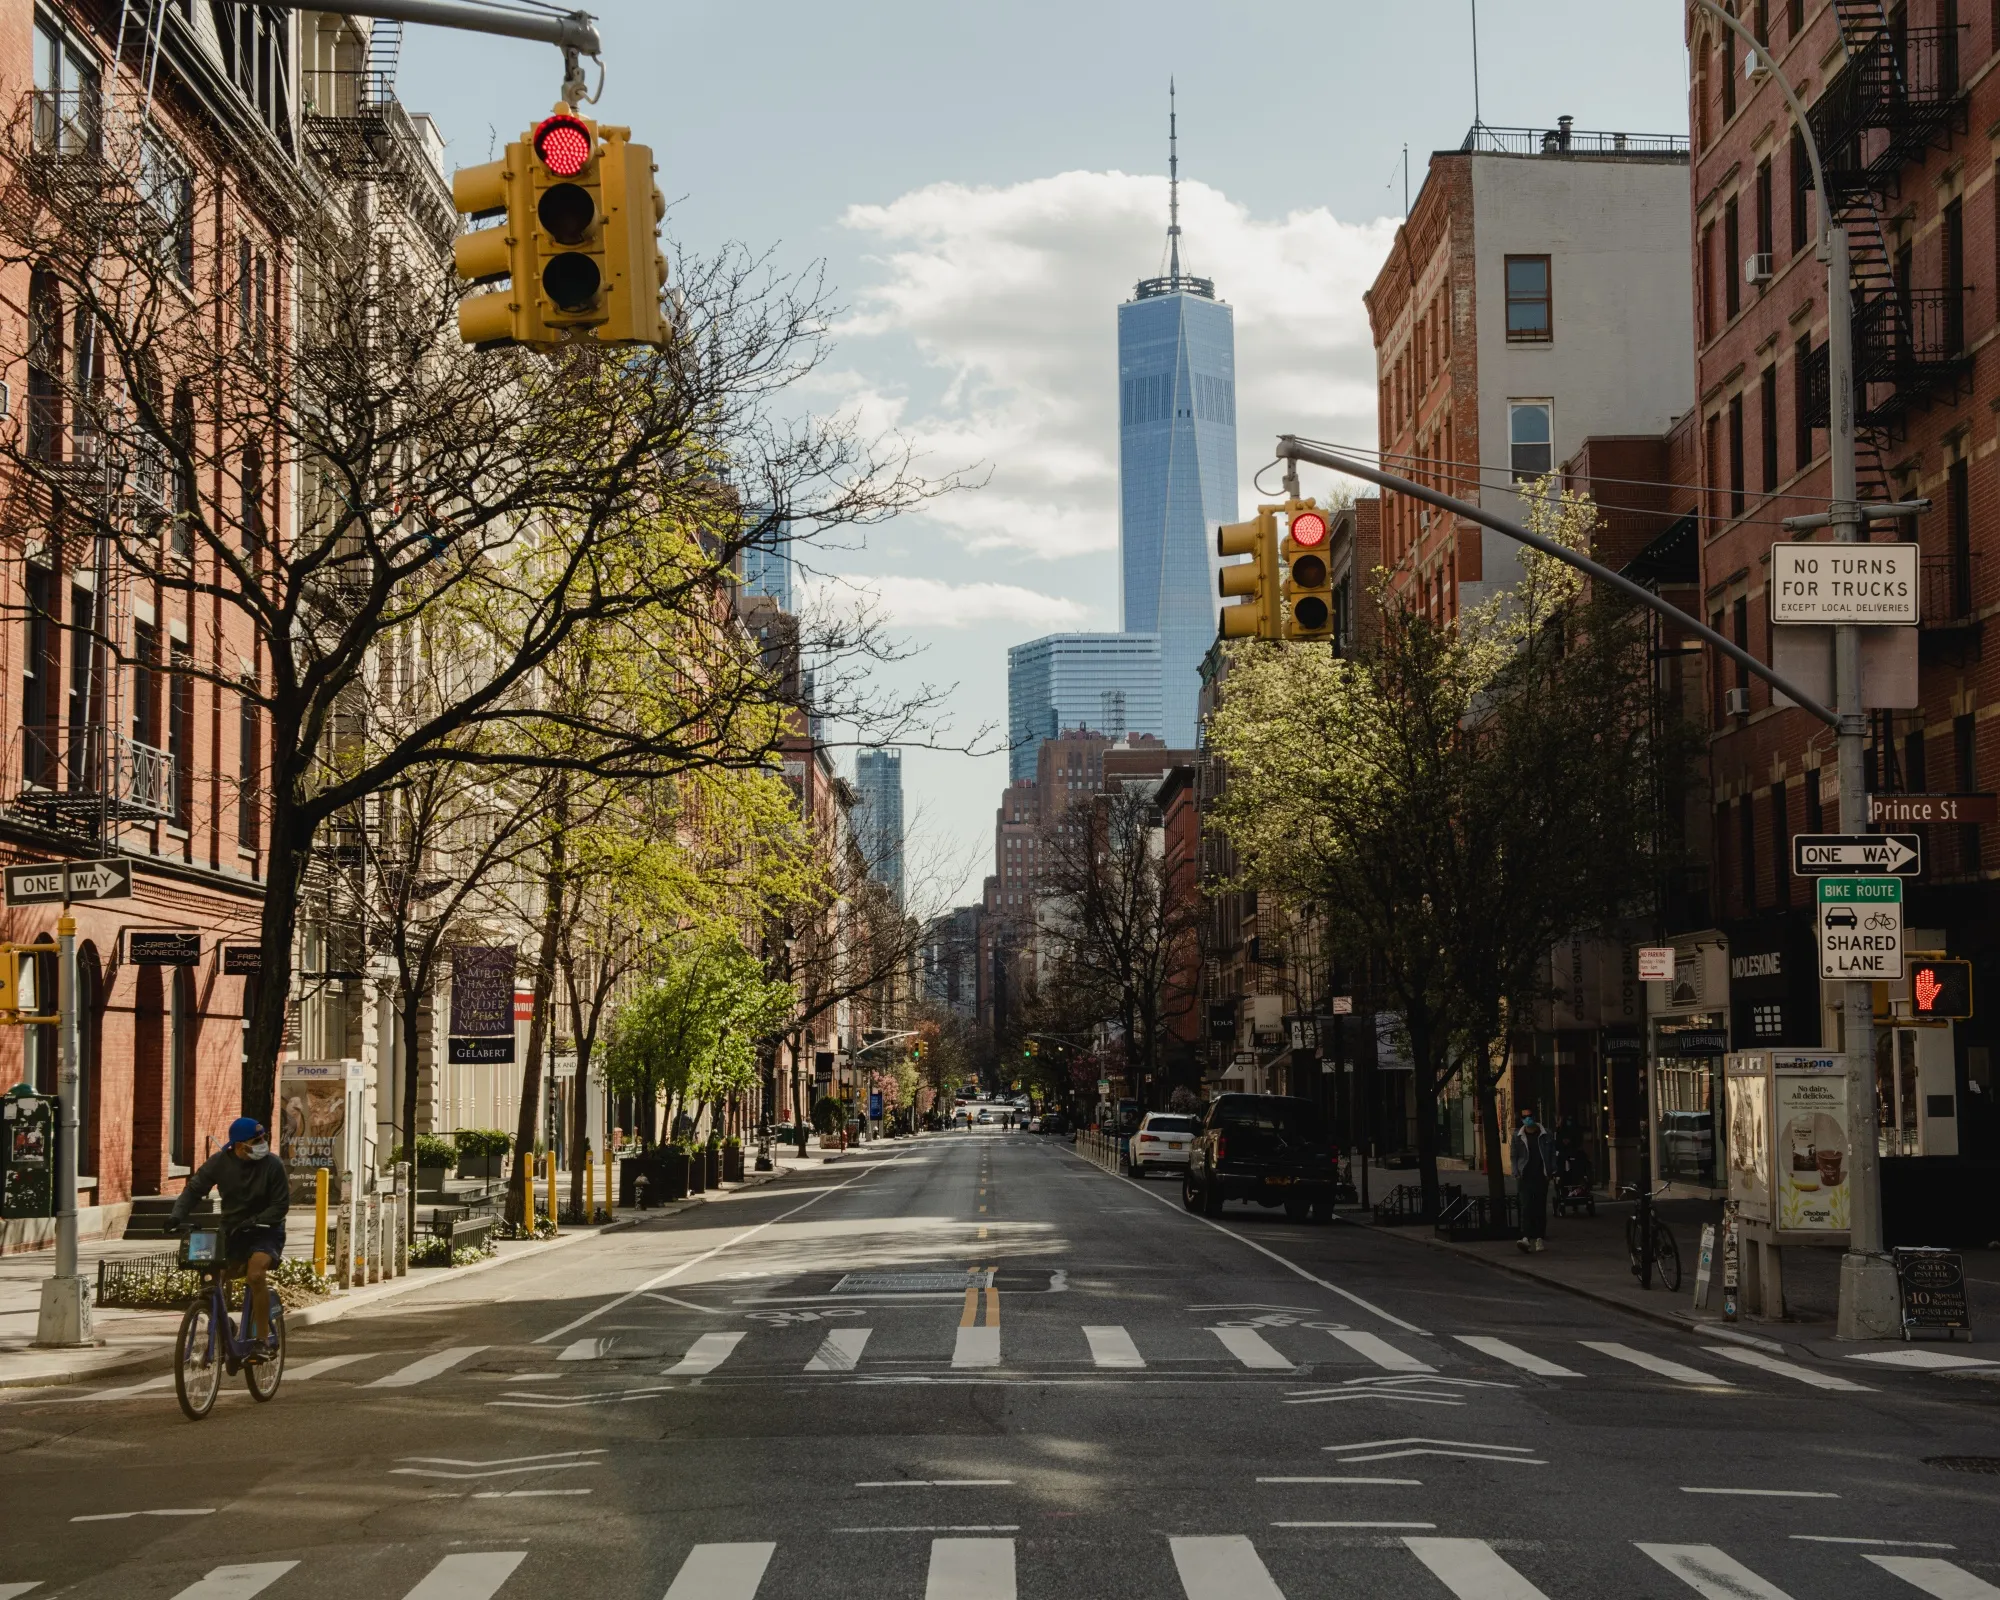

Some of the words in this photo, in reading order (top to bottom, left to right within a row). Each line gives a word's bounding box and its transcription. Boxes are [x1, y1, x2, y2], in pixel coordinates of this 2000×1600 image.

[1794, 559, 1819, 574] NO
[1831, 559, 1896, 574] TURNS
[1783, 581, 1818, 596] FOR
[1831, 581, 1908, 596] TRUCKS
[1781, 603, 1816, 612] EXCEPT
[1822, 603, 1852, 612] LOCAL
[1856, 603, 1909, 612] DELIVERIES
[1874, 800, 1932, 820] Prince
[1940, 800, 1958, 820] St
[1806, 847, 1842, 863] ONE
[1862, 847, 1902, 863] WAY
[24, 875, 59, 893] ONE
[75, 872, 112, 890] WAY
[1825, 885, 1851, 897] BIKE
[1857, 885, 1895, 897] ROUTE
[145, 941, 185, 949] FRENCH
[1827, 935, 1896, 951] SHARED
[1732, 952, 1781, 979] MOLESKINE
[1839, 955, 1884, 971] LANE
[1623, 980, 1634, 1016] SOLO
[1212, 1019, 1234, 1028] TOUS
[1681, 1036, 1725, 1050] VILEBREQUIN
[457, 1048, 507, 1059] GELABERT
[297, 1066, 328, 1075] Phone
[1797, 1085, 1808, 1093] No
[1809, 1085, 1829, 1094] dairy.
[1791, 1092, 1801, 1100] All
[1803, 1092, 1836, 1100] delicious.
[288, 1136, 305, 1146] WE
[307, 1136, 337, 1146] WANT
[295, 1146, 315, 1156] YOU
[316, 1146, 331, 1156] TO
[290, 1157, 335, 1167] CHANGE
[1803, 1210, 1831, 1218] Chobani
[1809, 1215, 1824, 1223] Café
[1934, 1291, 1962, 1300] Special
[1932, 1299, 1966, 1308] Readings
